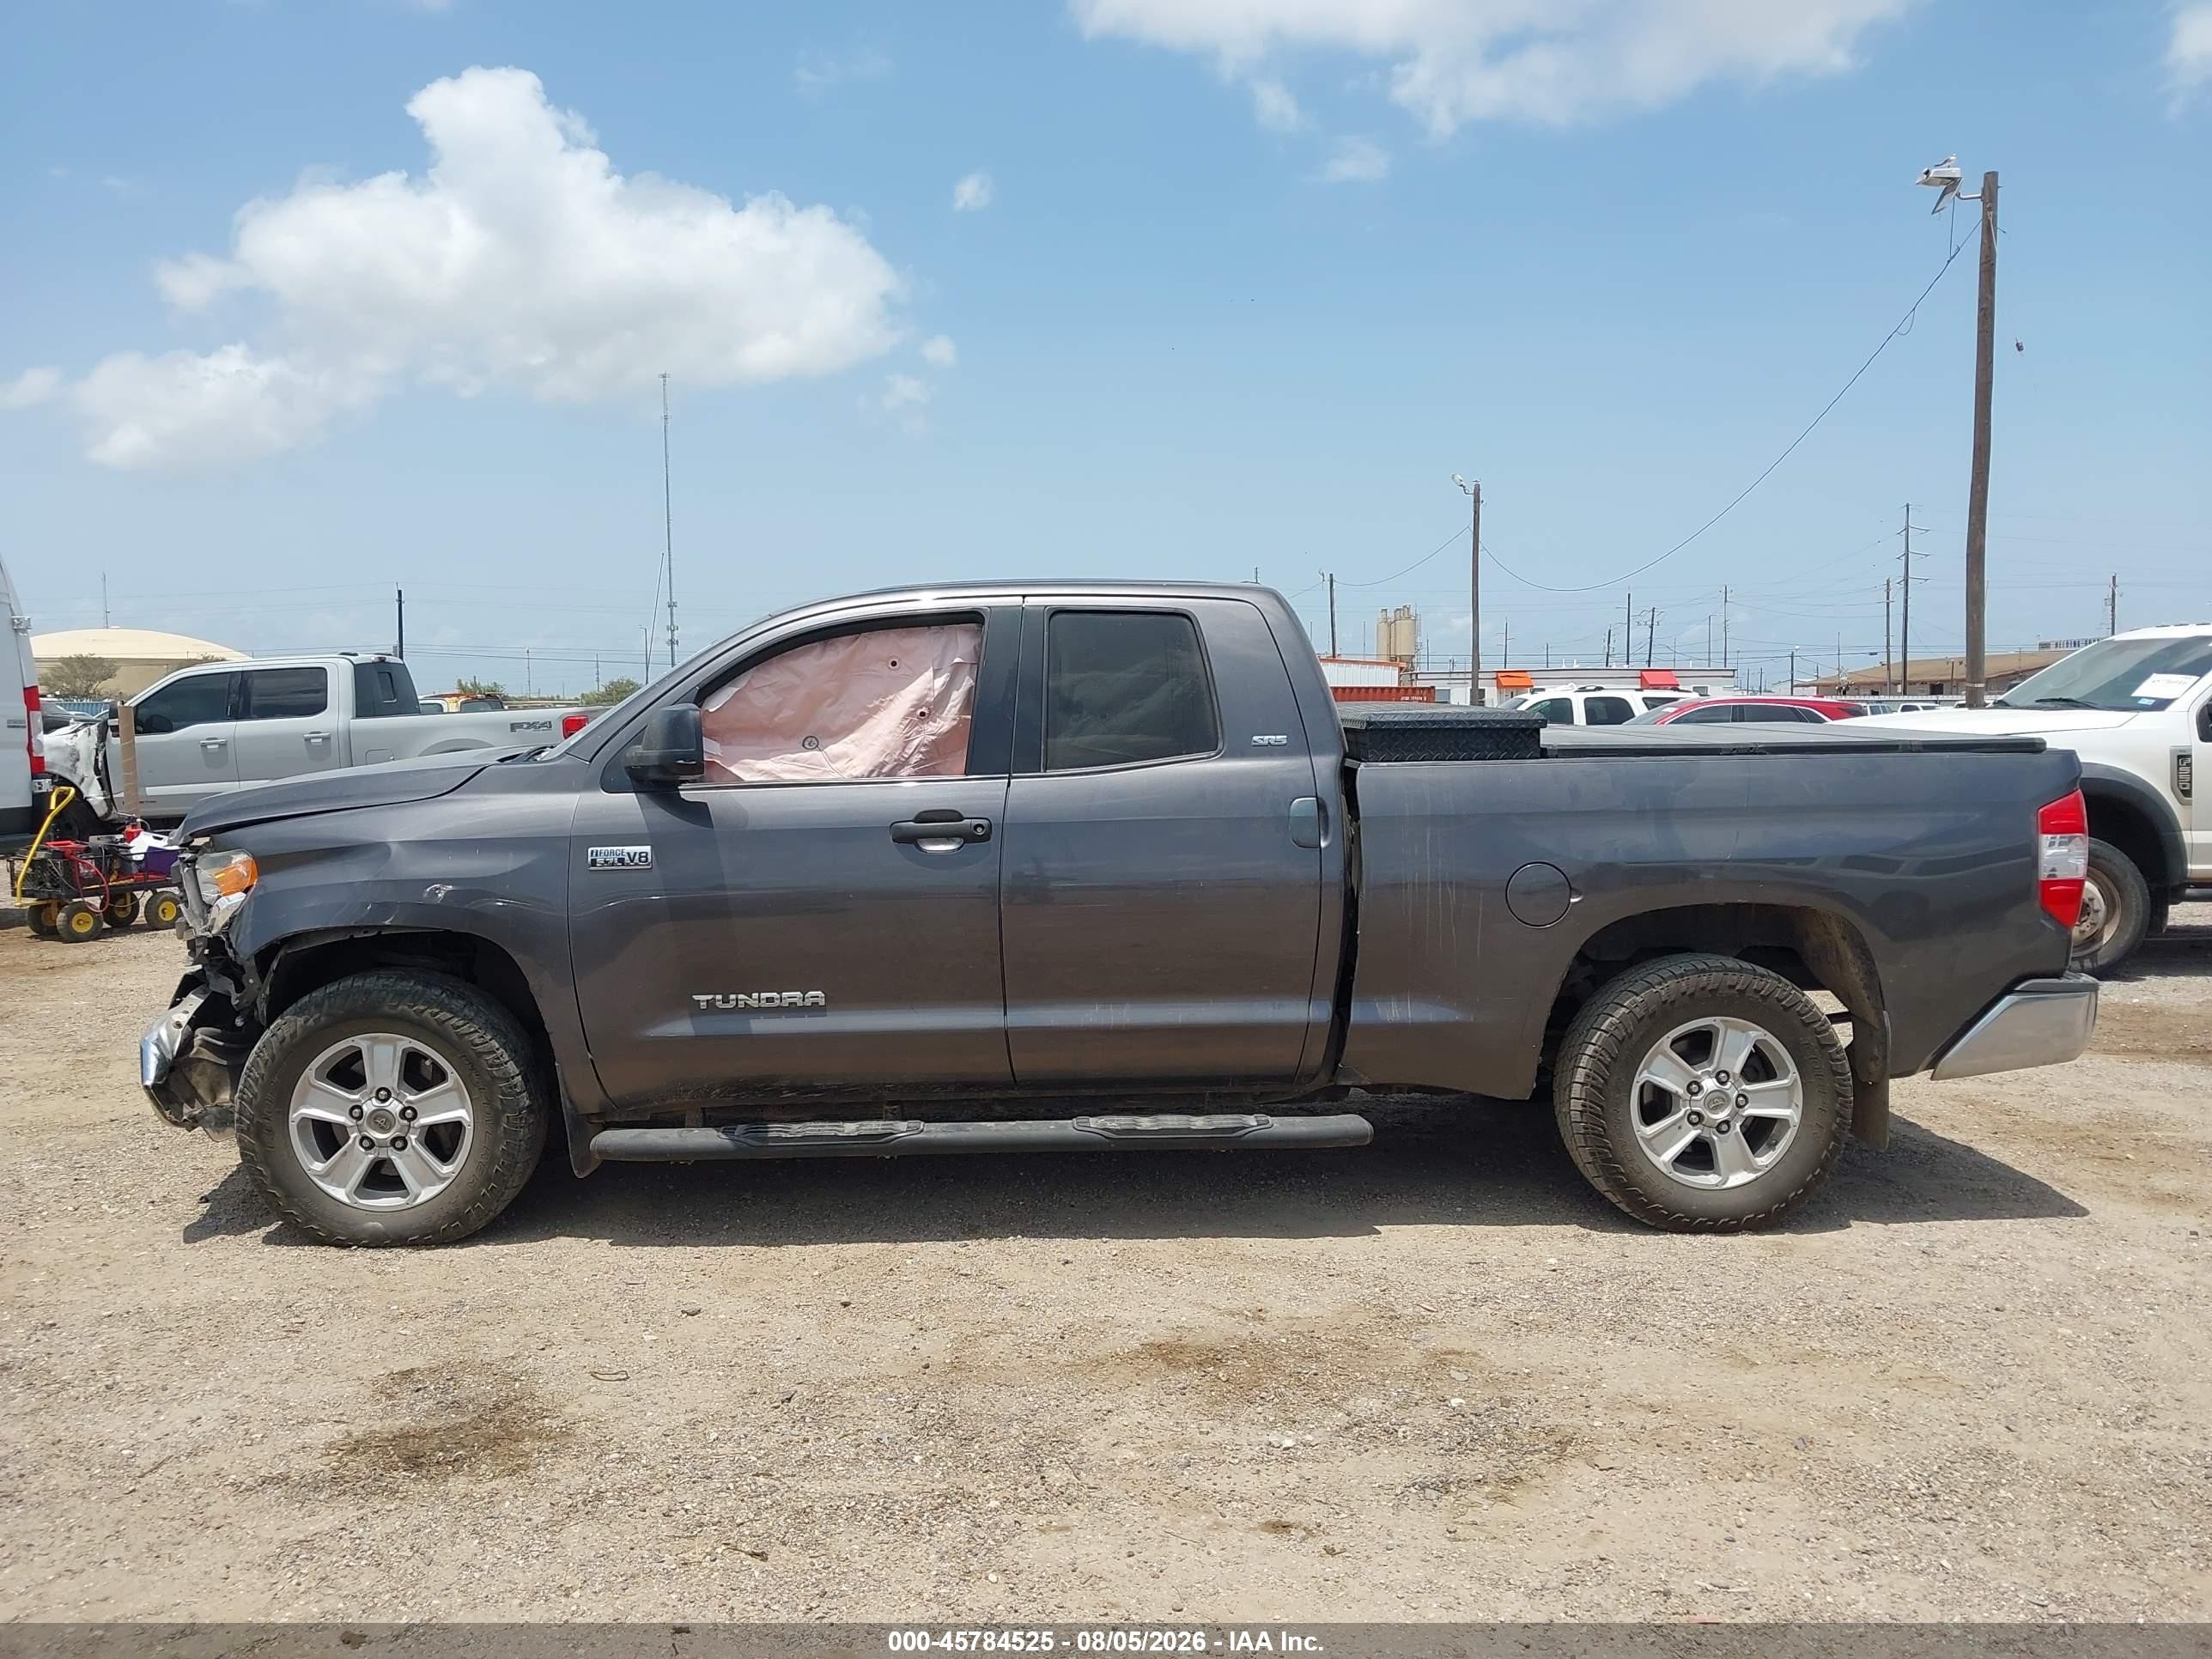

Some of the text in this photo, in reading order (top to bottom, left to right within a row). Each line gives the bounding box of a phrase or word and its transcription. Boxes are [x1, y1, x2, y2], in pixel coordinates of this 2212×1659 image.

[510, 720, 553, 732] FX4
[1251, 735, 1287, 745] SR5
[626, 851, 648, 864] V8
[692, 991, 825, 1010] TUNDRA
